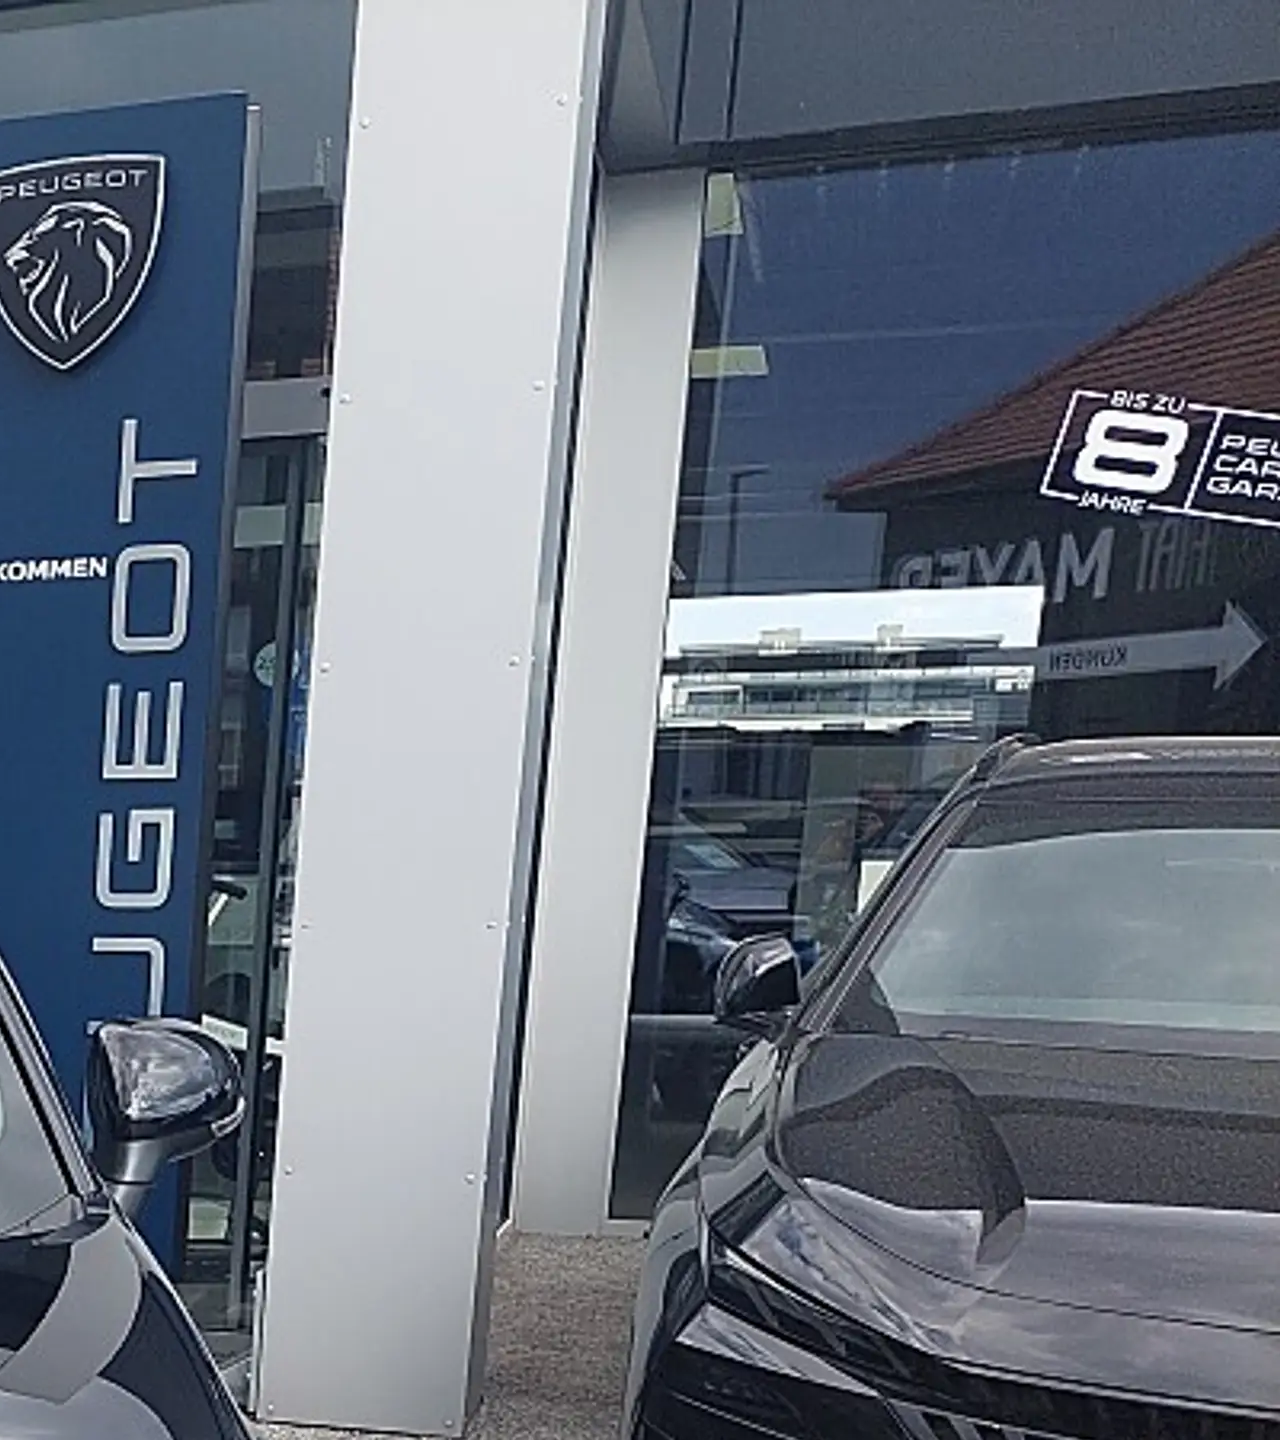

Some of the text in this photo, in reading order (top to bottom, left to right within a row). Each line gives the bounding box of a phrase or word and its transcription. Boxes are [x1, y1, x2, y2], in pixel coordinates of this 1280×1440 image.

[1110, 389, 1186, 414] BIS ZU
[1072, 408, 1190, 494] 8
[1077, 489, 1148, 516] JAHRE
